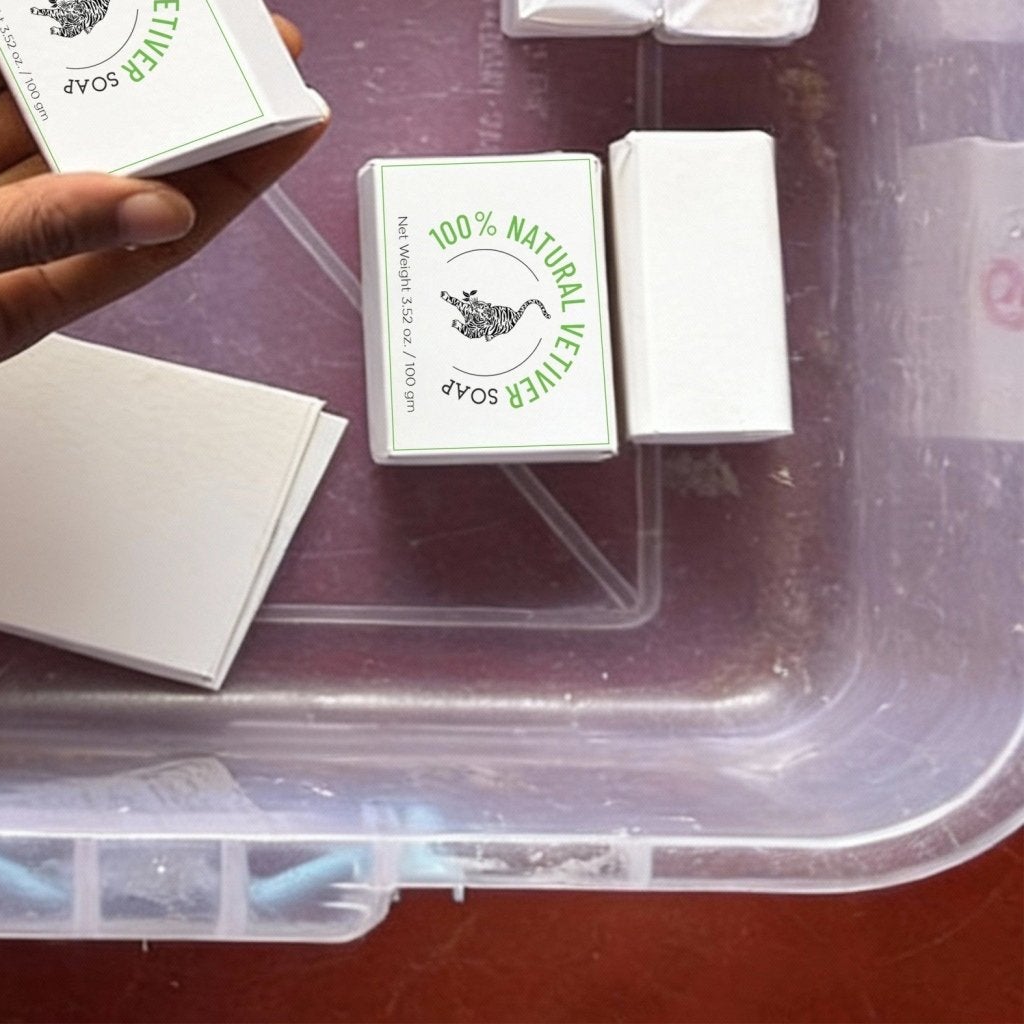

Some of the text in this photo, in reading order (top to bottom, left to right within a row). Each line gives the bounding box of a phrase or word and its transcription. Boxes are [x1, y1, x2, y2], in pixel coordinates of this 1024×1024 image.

[10, 51, 24, 71] oz.
[24, 76, 41, 100] 100
[63, 71, 120, 95] SOAP
[32, 99, 49, 122] gm
[397, 215, 408, 241] Net
[397, 243, 412, 293] Weight
[401, 296, 414, 325] 3.52
[428, 210, 586, 409] 100% NATURAL VETIVER SOAP
[402, 328, 413, 348] oz.
[404, 362, 417, 388] 100
[403, 390, 416, 414] gm
